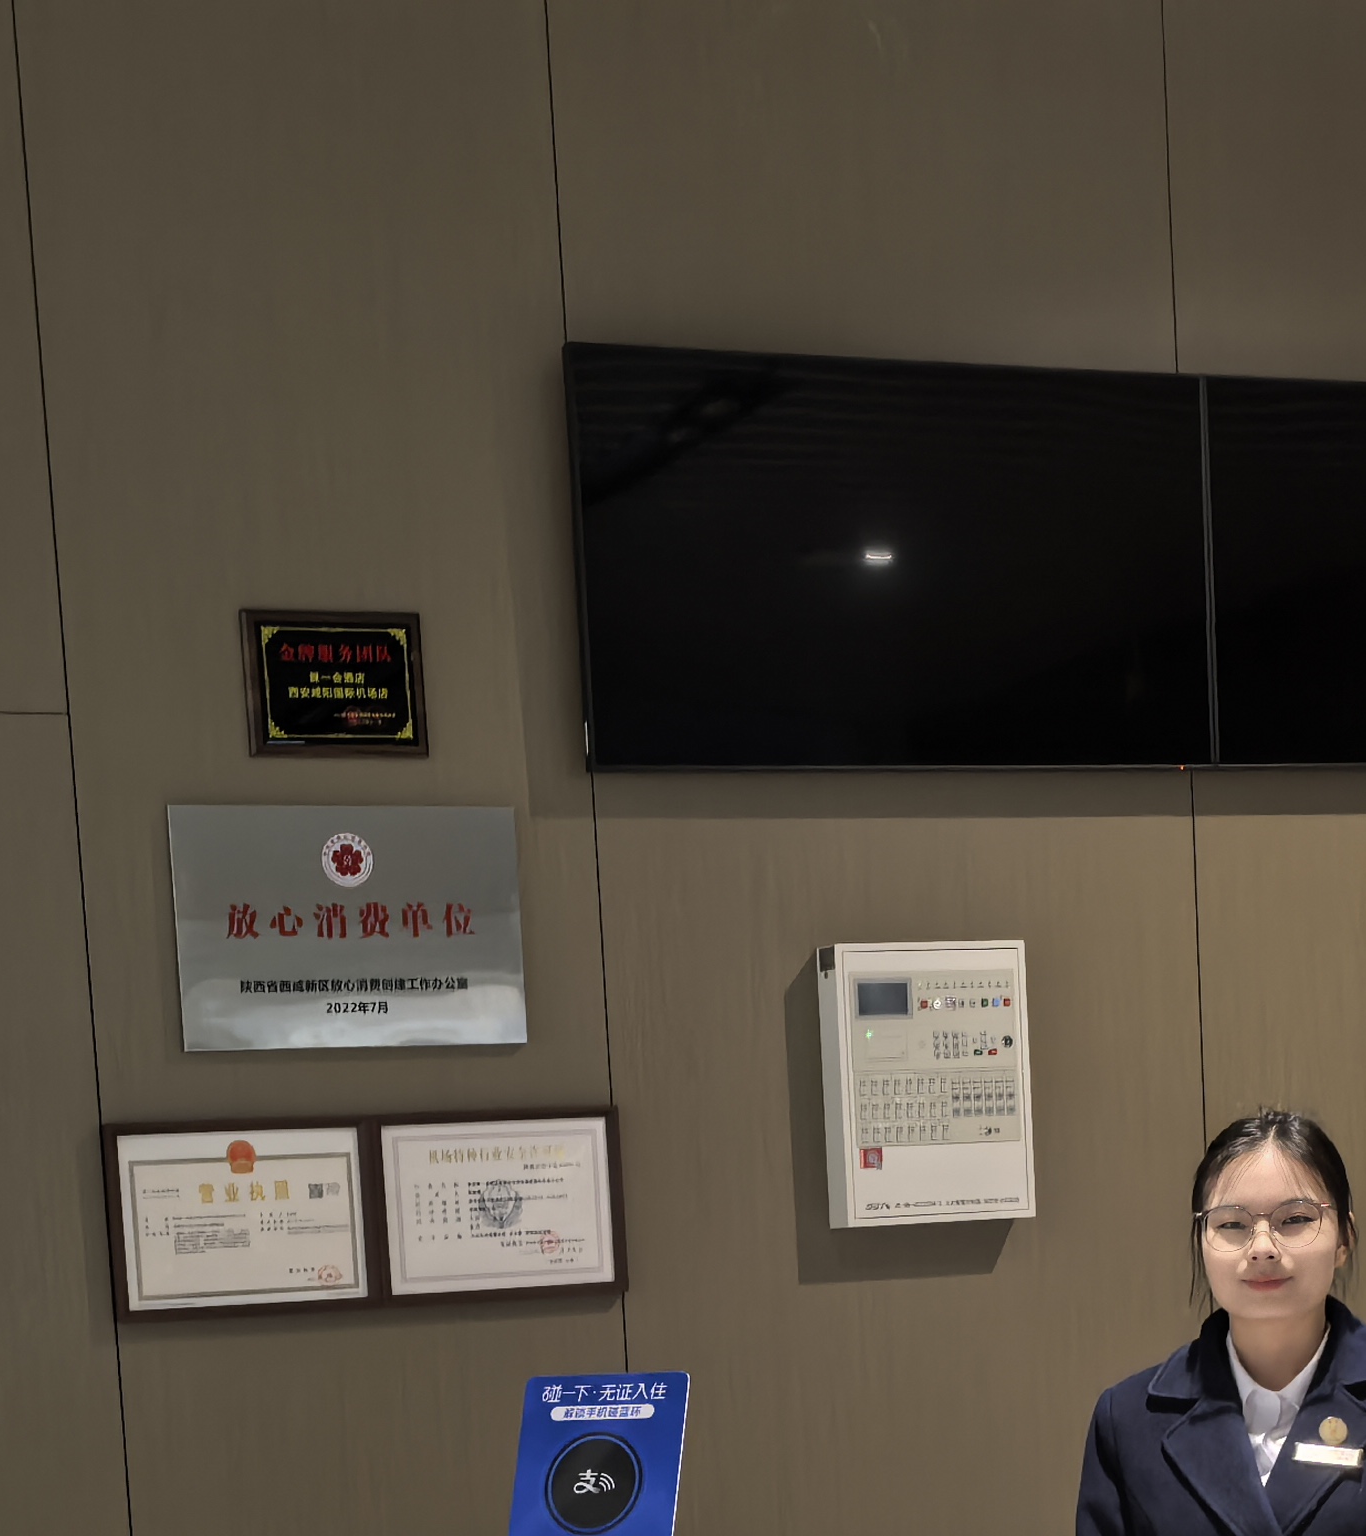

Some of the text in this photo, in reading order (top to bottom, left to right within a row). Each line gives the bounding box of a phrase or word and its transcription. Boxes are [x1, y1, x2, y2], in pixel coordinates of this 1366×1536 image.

[280, 643, 392, 664] 金牌服务团队
[226, 902, 476, 941] 放心消费单位
[326, 1001, 389, 1015] 2022年7月
[199, 1179, 290, 1204] 营业执照
